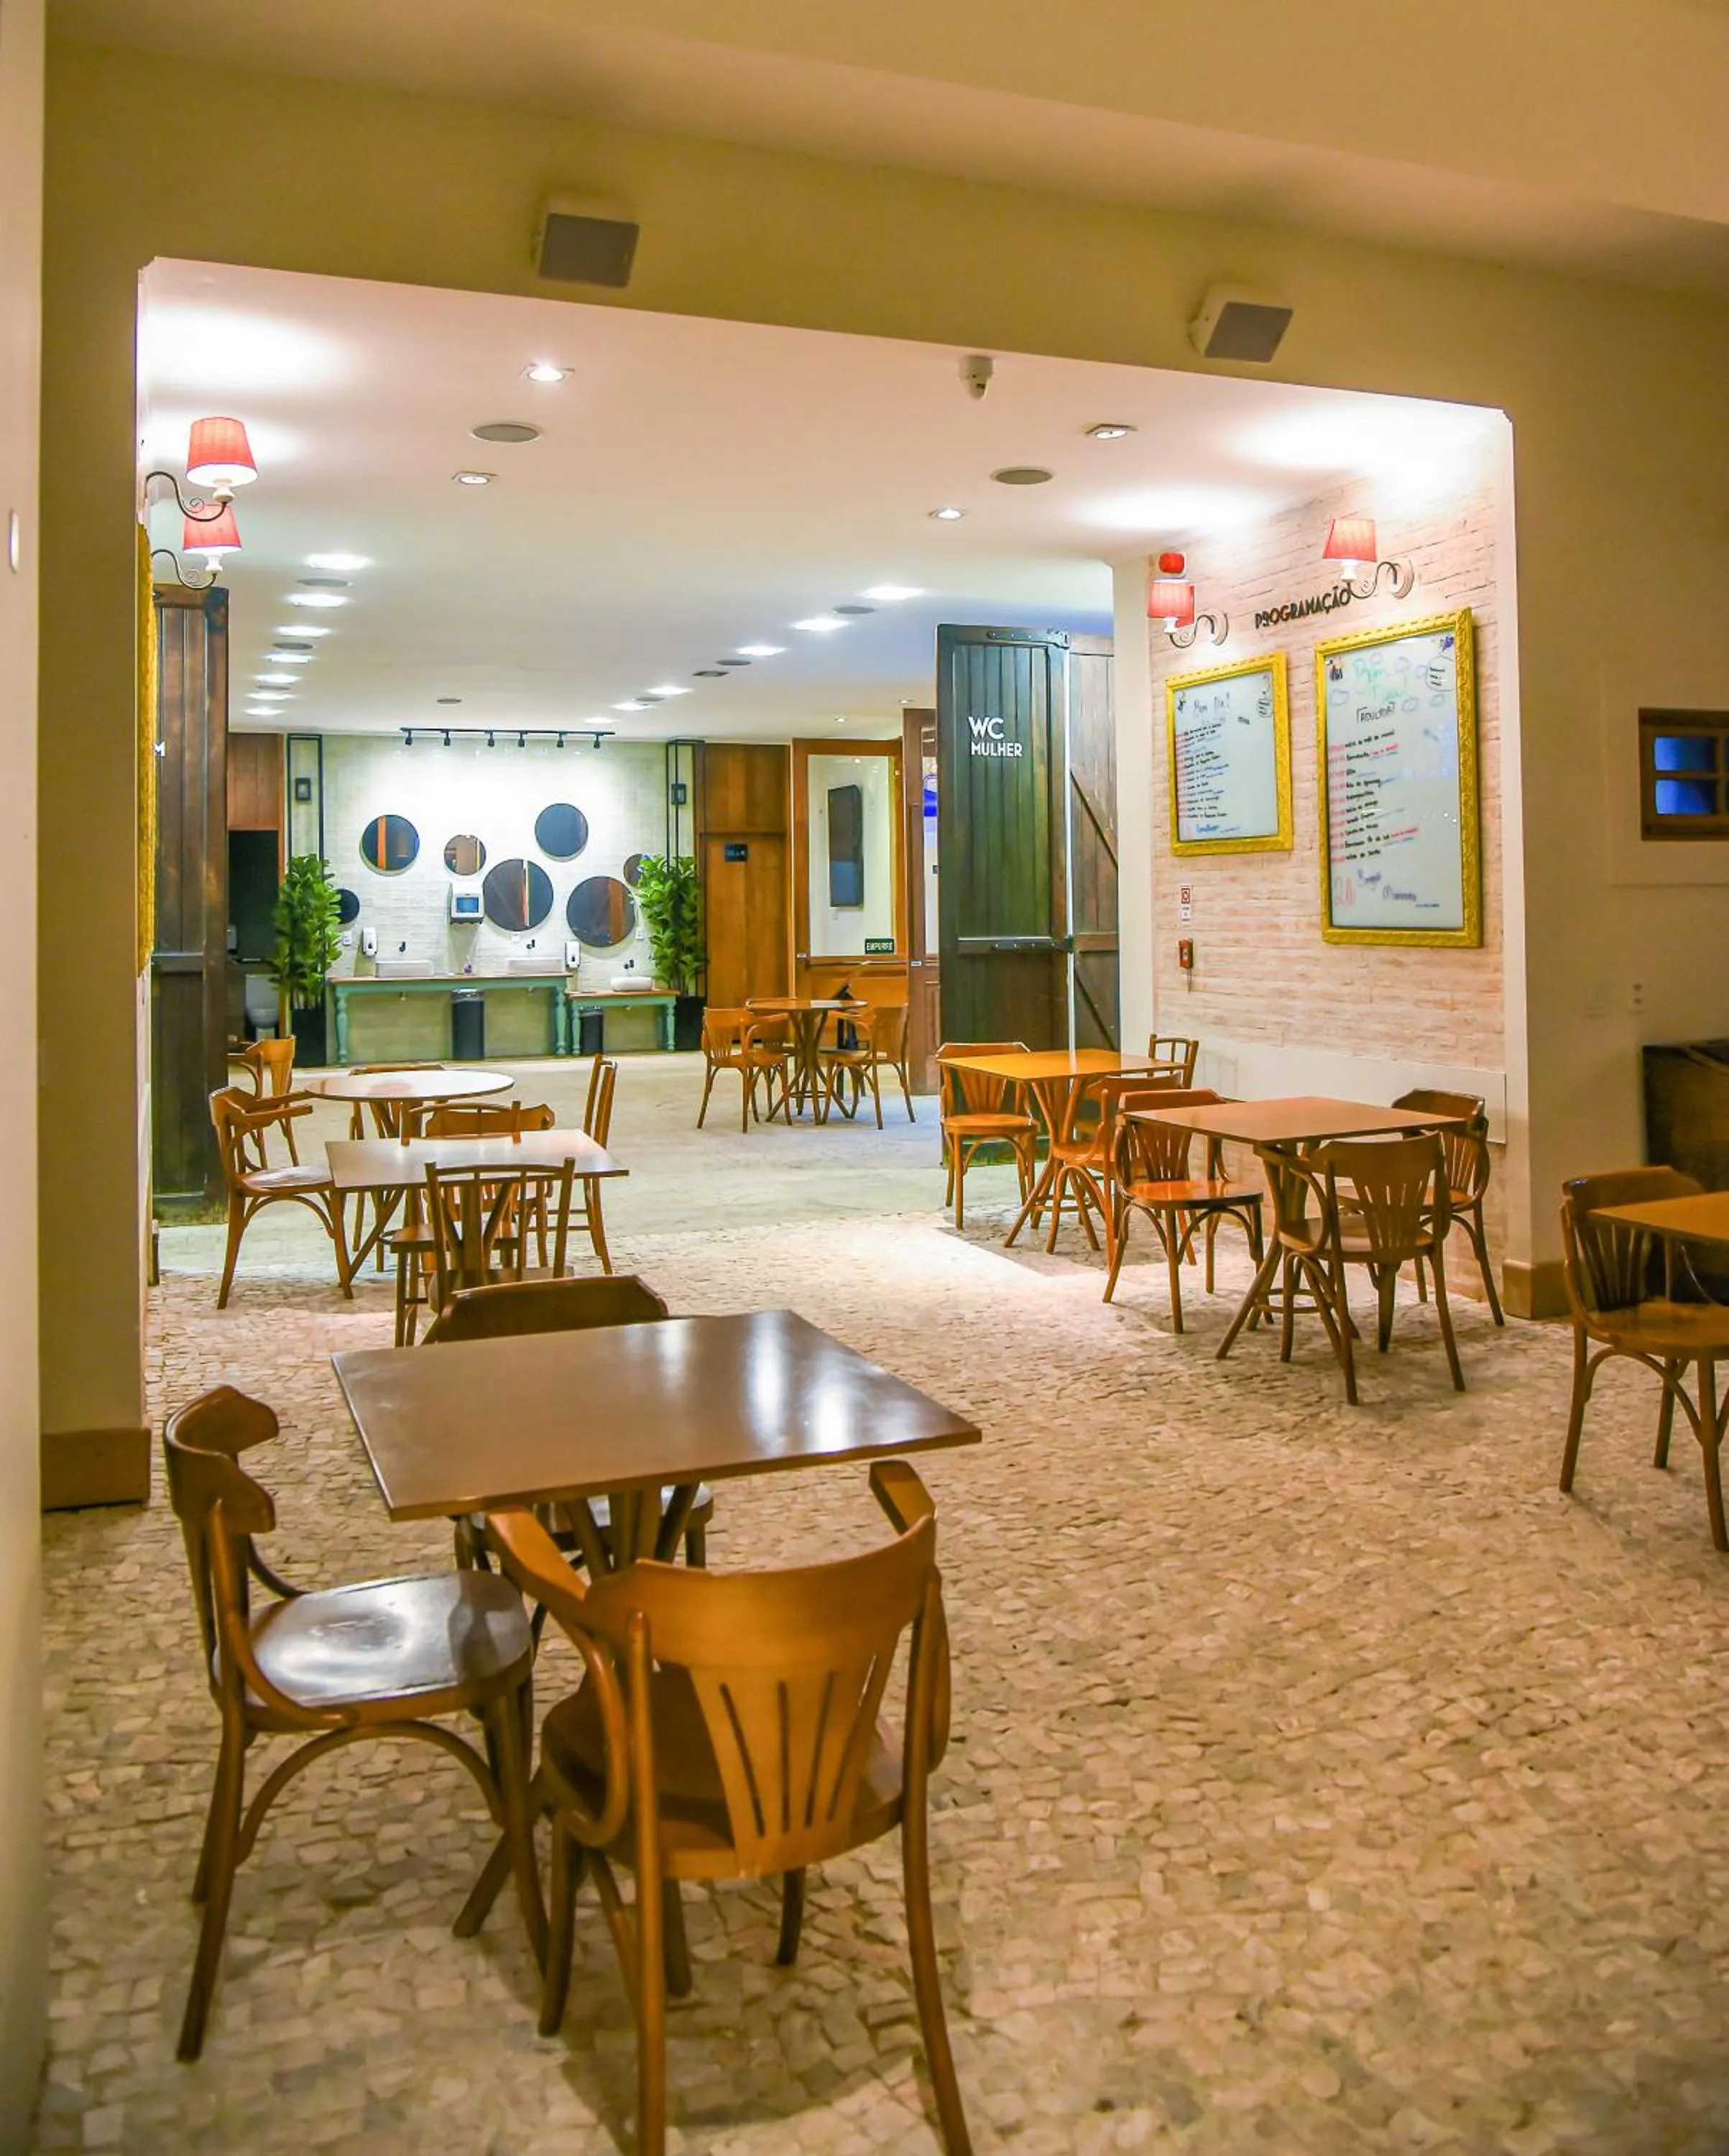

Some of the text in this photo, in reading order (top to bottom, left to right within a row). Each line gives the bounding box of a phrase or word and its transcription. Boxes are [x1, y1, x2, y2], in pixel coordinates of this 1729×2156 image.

[1254, 586, 1351, 629] PROGRAMAÇÃO
[968, 717, 1004, 740] WC
[970, 742, 1023, 757] MULHER
